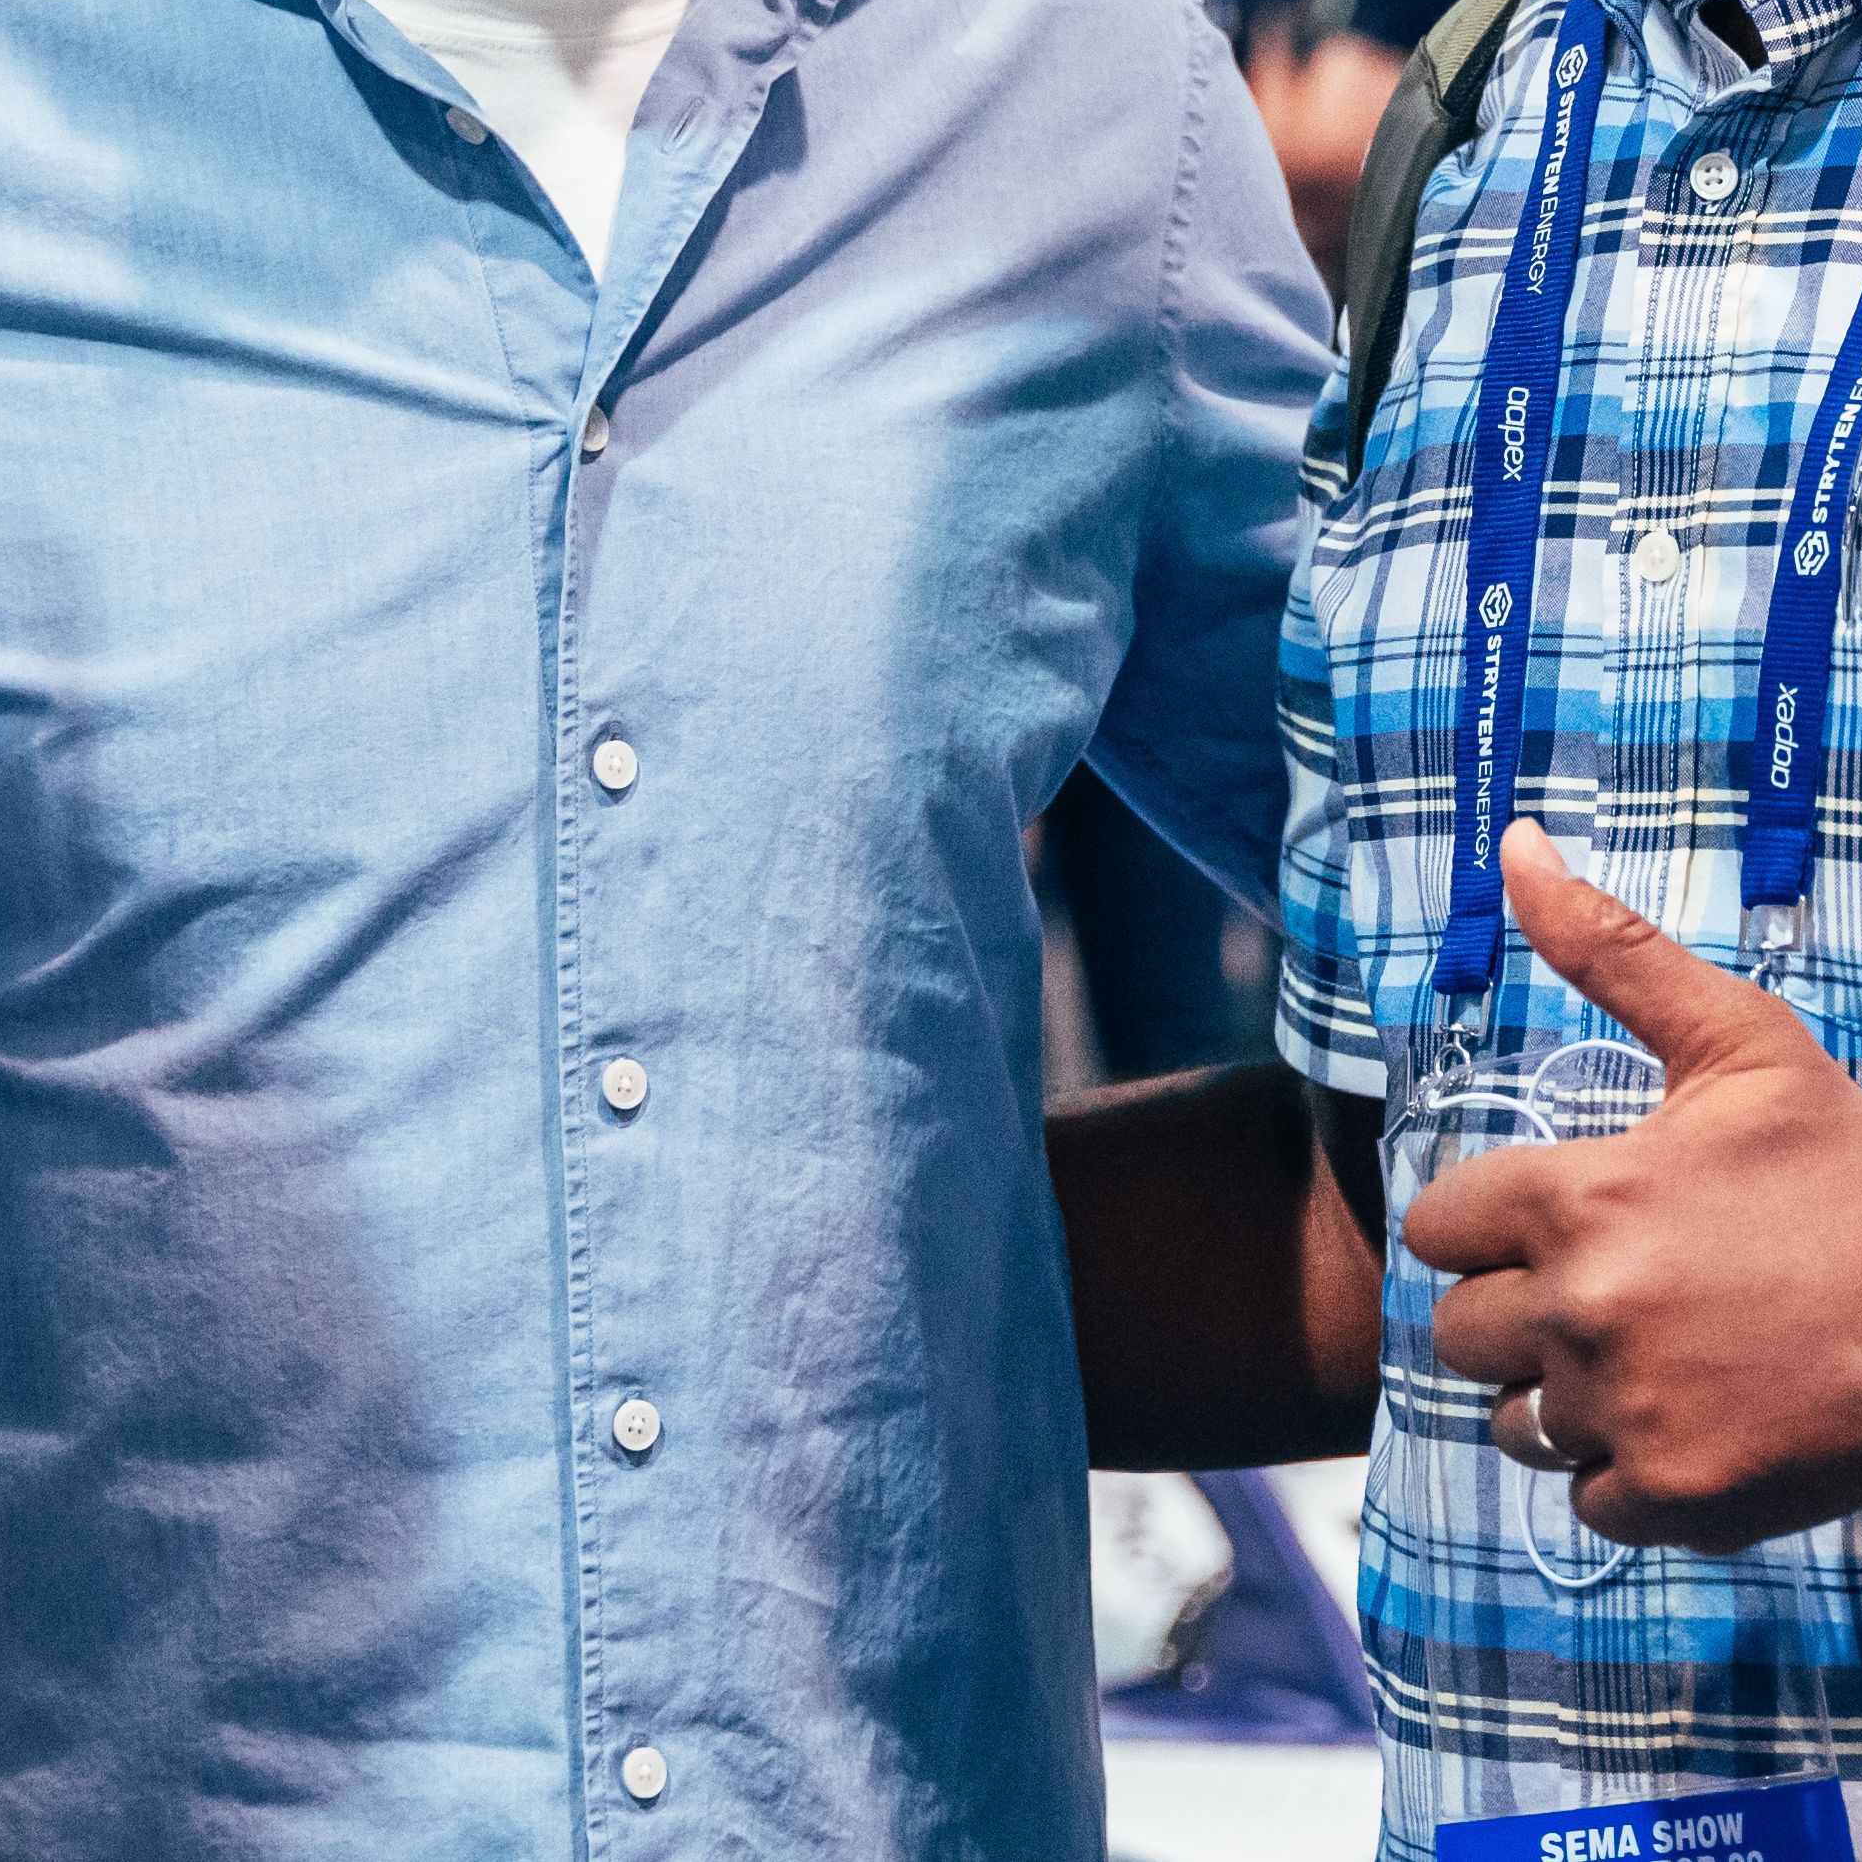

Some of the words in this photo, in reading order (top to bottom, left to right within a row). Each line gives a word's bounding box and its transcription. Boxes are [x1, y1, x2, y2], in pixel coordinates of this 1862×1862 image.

[1543, 91, 1575, 194] STRYTEN
[1526, 196, 1560, 295] ENERGY
[1499, 386, 1529, 482] aapex
[1811, 403, 1857, 524] STRYTEN
[1477, 634, 1502, 755] STRYTEN
[1770, 682, 1798, 790] aapex
[1472, 758, 1491, 871] ENERGY
[1540, 1824, 1640, 1862] SEMA
[1652, 1812, 1744, 1853] SHOW
